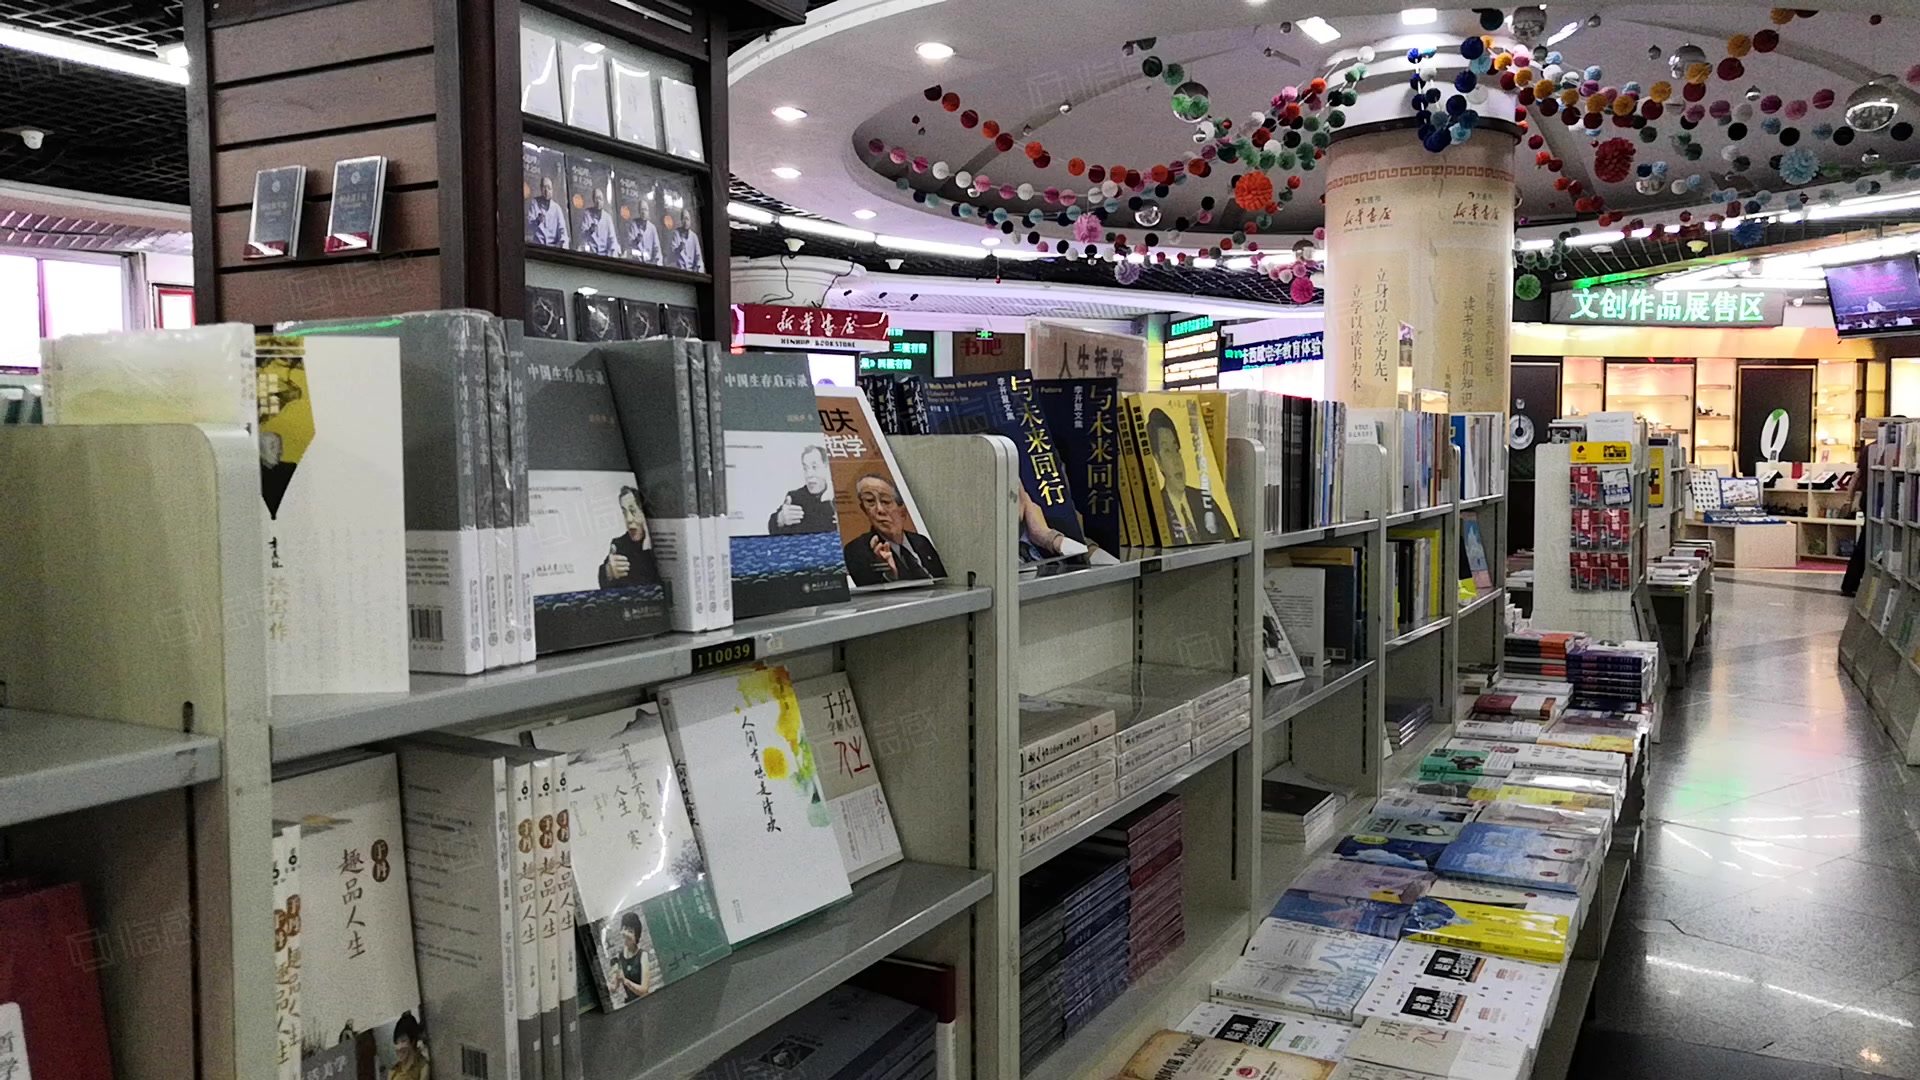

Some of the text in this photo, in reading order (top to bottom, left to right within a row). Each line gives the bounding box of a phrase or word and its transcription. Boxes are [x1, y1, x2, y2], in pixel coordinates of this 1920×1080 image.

[776, 306, 860, 337] 新华书店
[1570, 287, 1766, 323] 文创作品展售区
[527, 363, 606, 386] 中国生存启示录
[1059, 341, 1125, 379] 人生哲学
[724, 373, 809, 388] 中国生存启示录
[1010, 375, 1066, 506] 与未来同行
[1086, 384, 1115, 516] 与未来同行
[698, 646, 751, 668] 110039
[337, 848, 366, 960] 趣品人生
